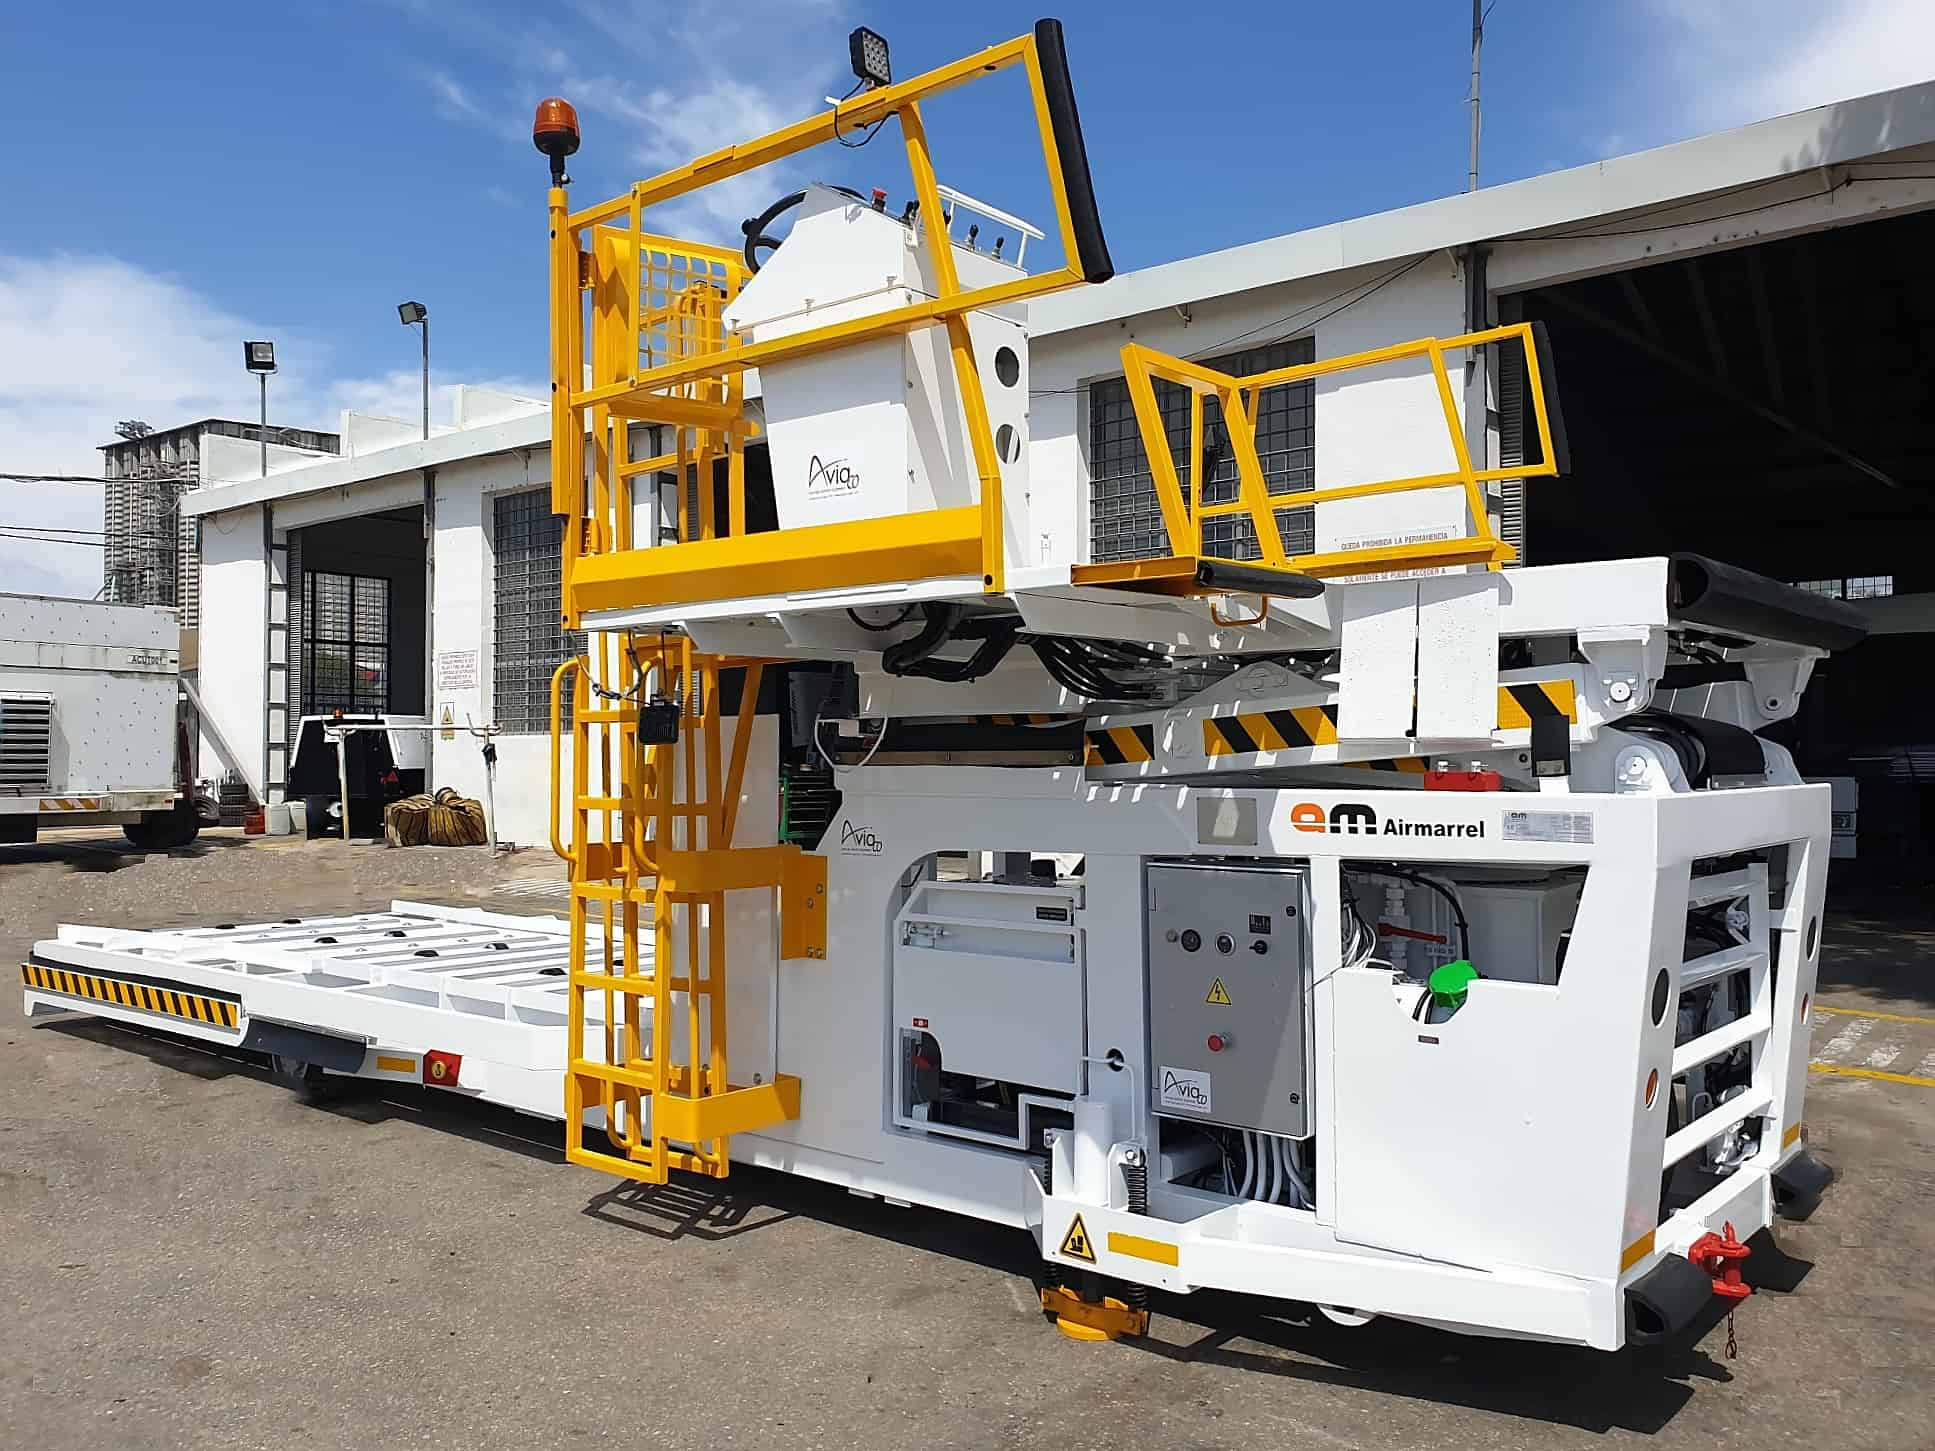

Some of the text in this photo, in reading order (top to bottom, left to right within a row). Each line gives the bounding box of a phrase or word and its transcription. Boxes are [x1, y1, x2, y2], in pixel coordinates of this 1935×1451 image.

[1394, 536, 1403, 545] LA
[1404, 532, 1448, 543] PERMANENCIA
[1383, 818, 1485, 837] Airmarrel
